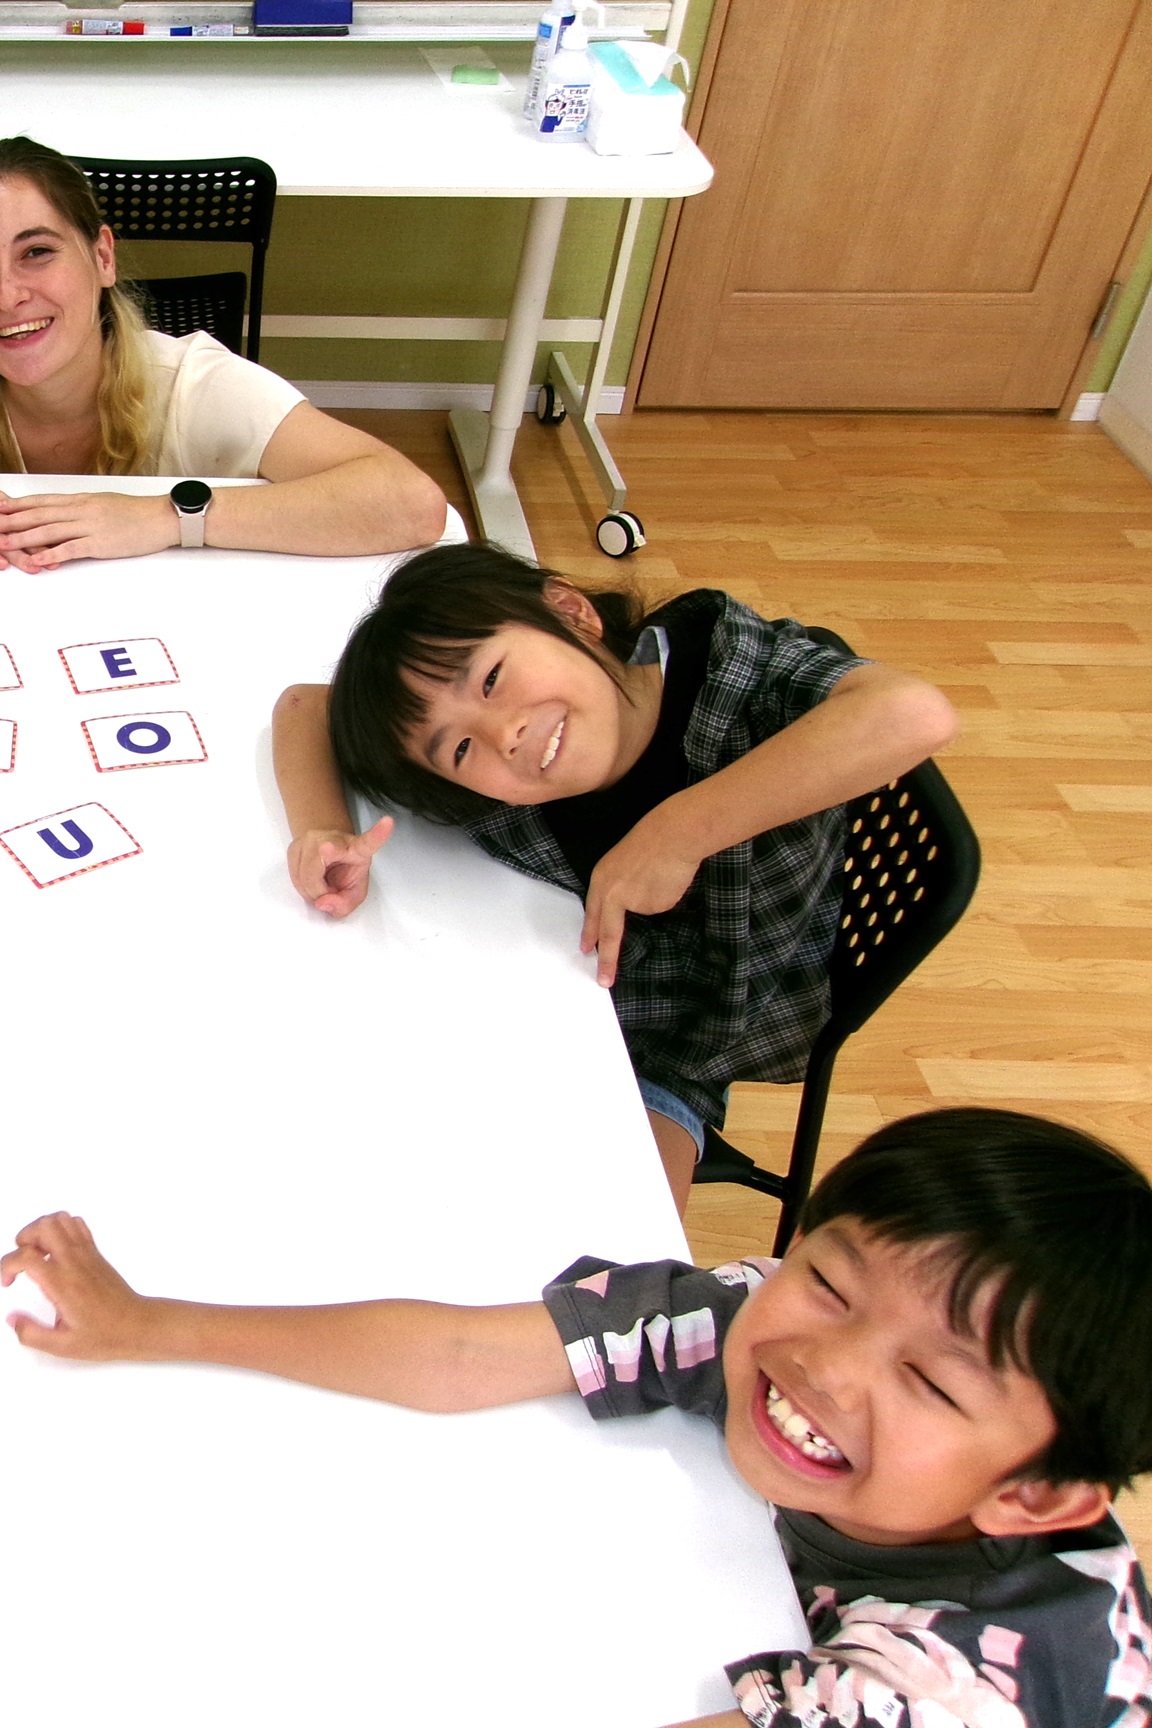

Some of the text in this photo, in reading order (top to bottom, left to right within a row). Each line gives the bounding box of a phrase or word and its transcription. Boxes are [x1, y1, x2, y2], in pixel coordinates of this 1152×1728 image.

[100, 647, 137, 678] E
[116, 721, 171, 754] O
[36, 819, 94, 859] U
